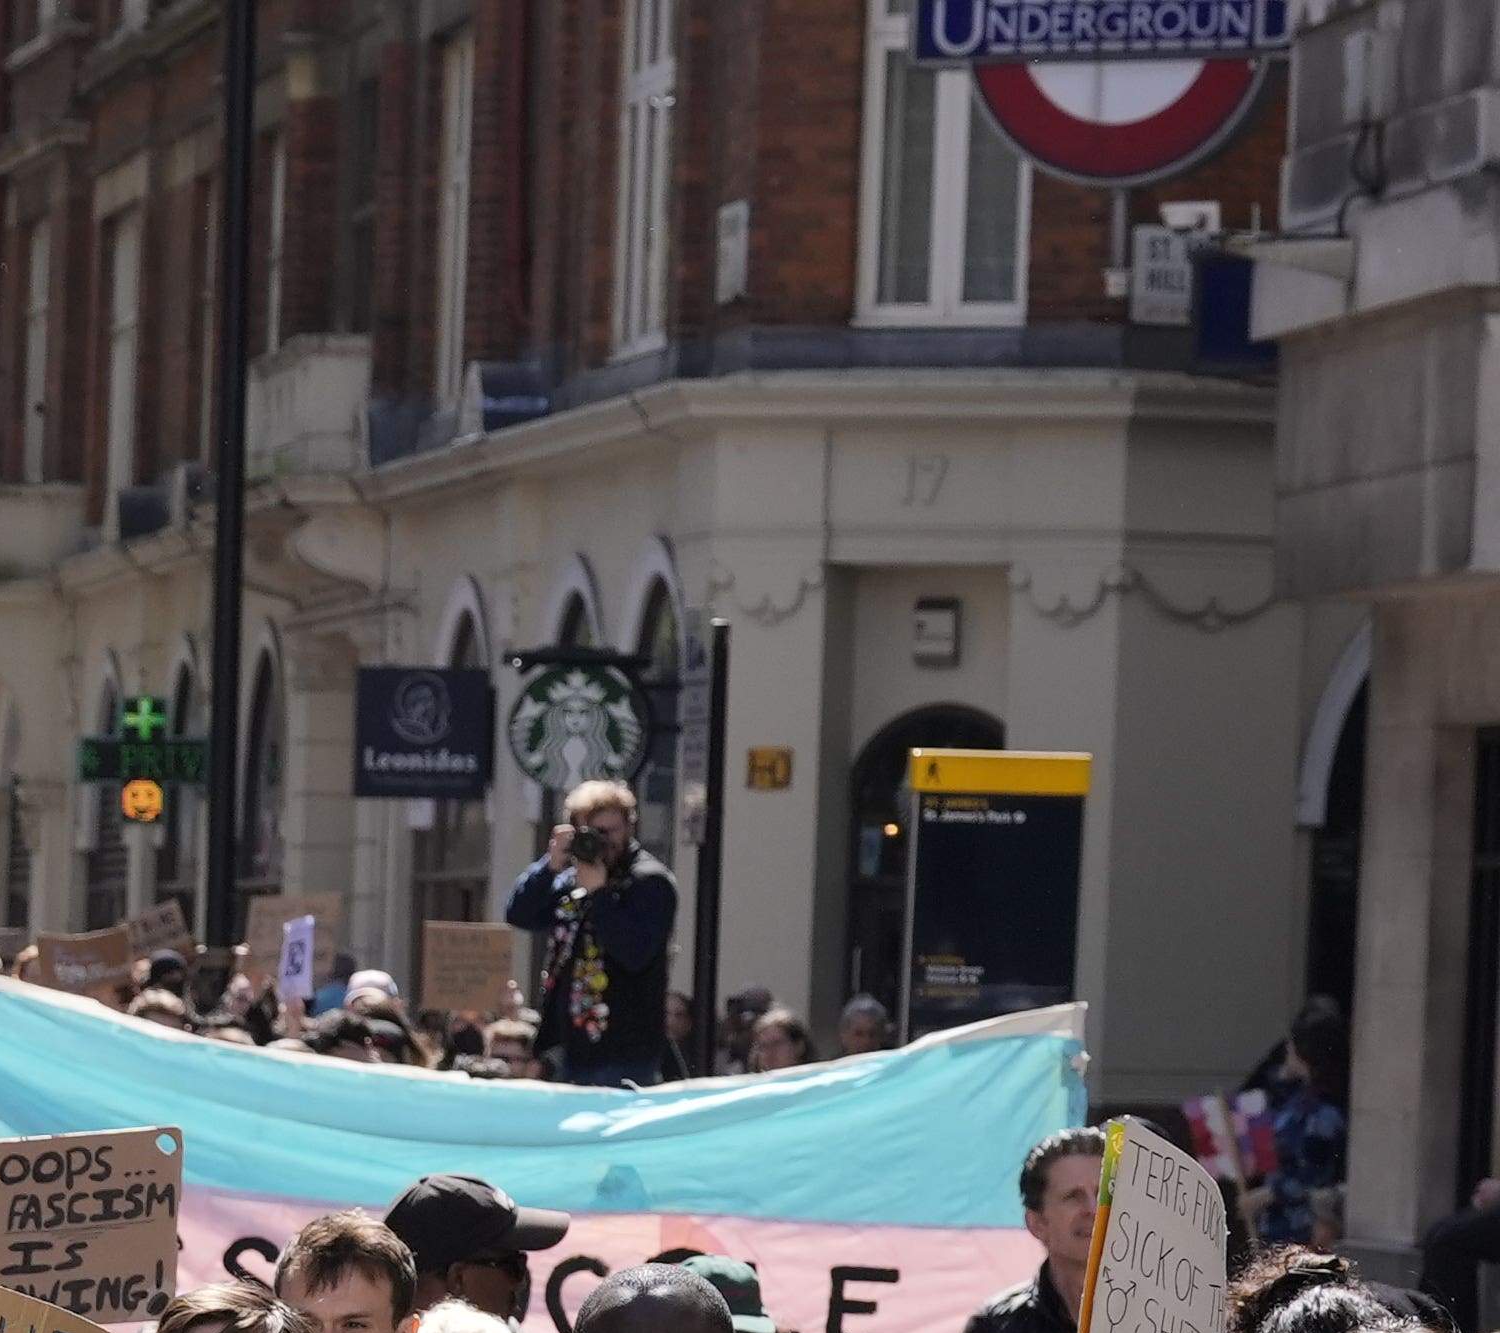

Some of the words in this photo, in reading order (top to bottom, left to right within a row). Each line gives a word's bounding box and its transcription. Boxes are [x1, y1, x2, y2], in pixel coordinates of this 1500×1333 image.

[932, 0, 1294, 56] UNDERGROUND
[362, 745, 479, 772] Leonidas
[6, 1181, 176, 1232] FASCISM
[0, 1240, 89, 1276] IS
[1109, 1210, 1175, 1290] SICK
[1174, 1256, 1204, 1308] OF
